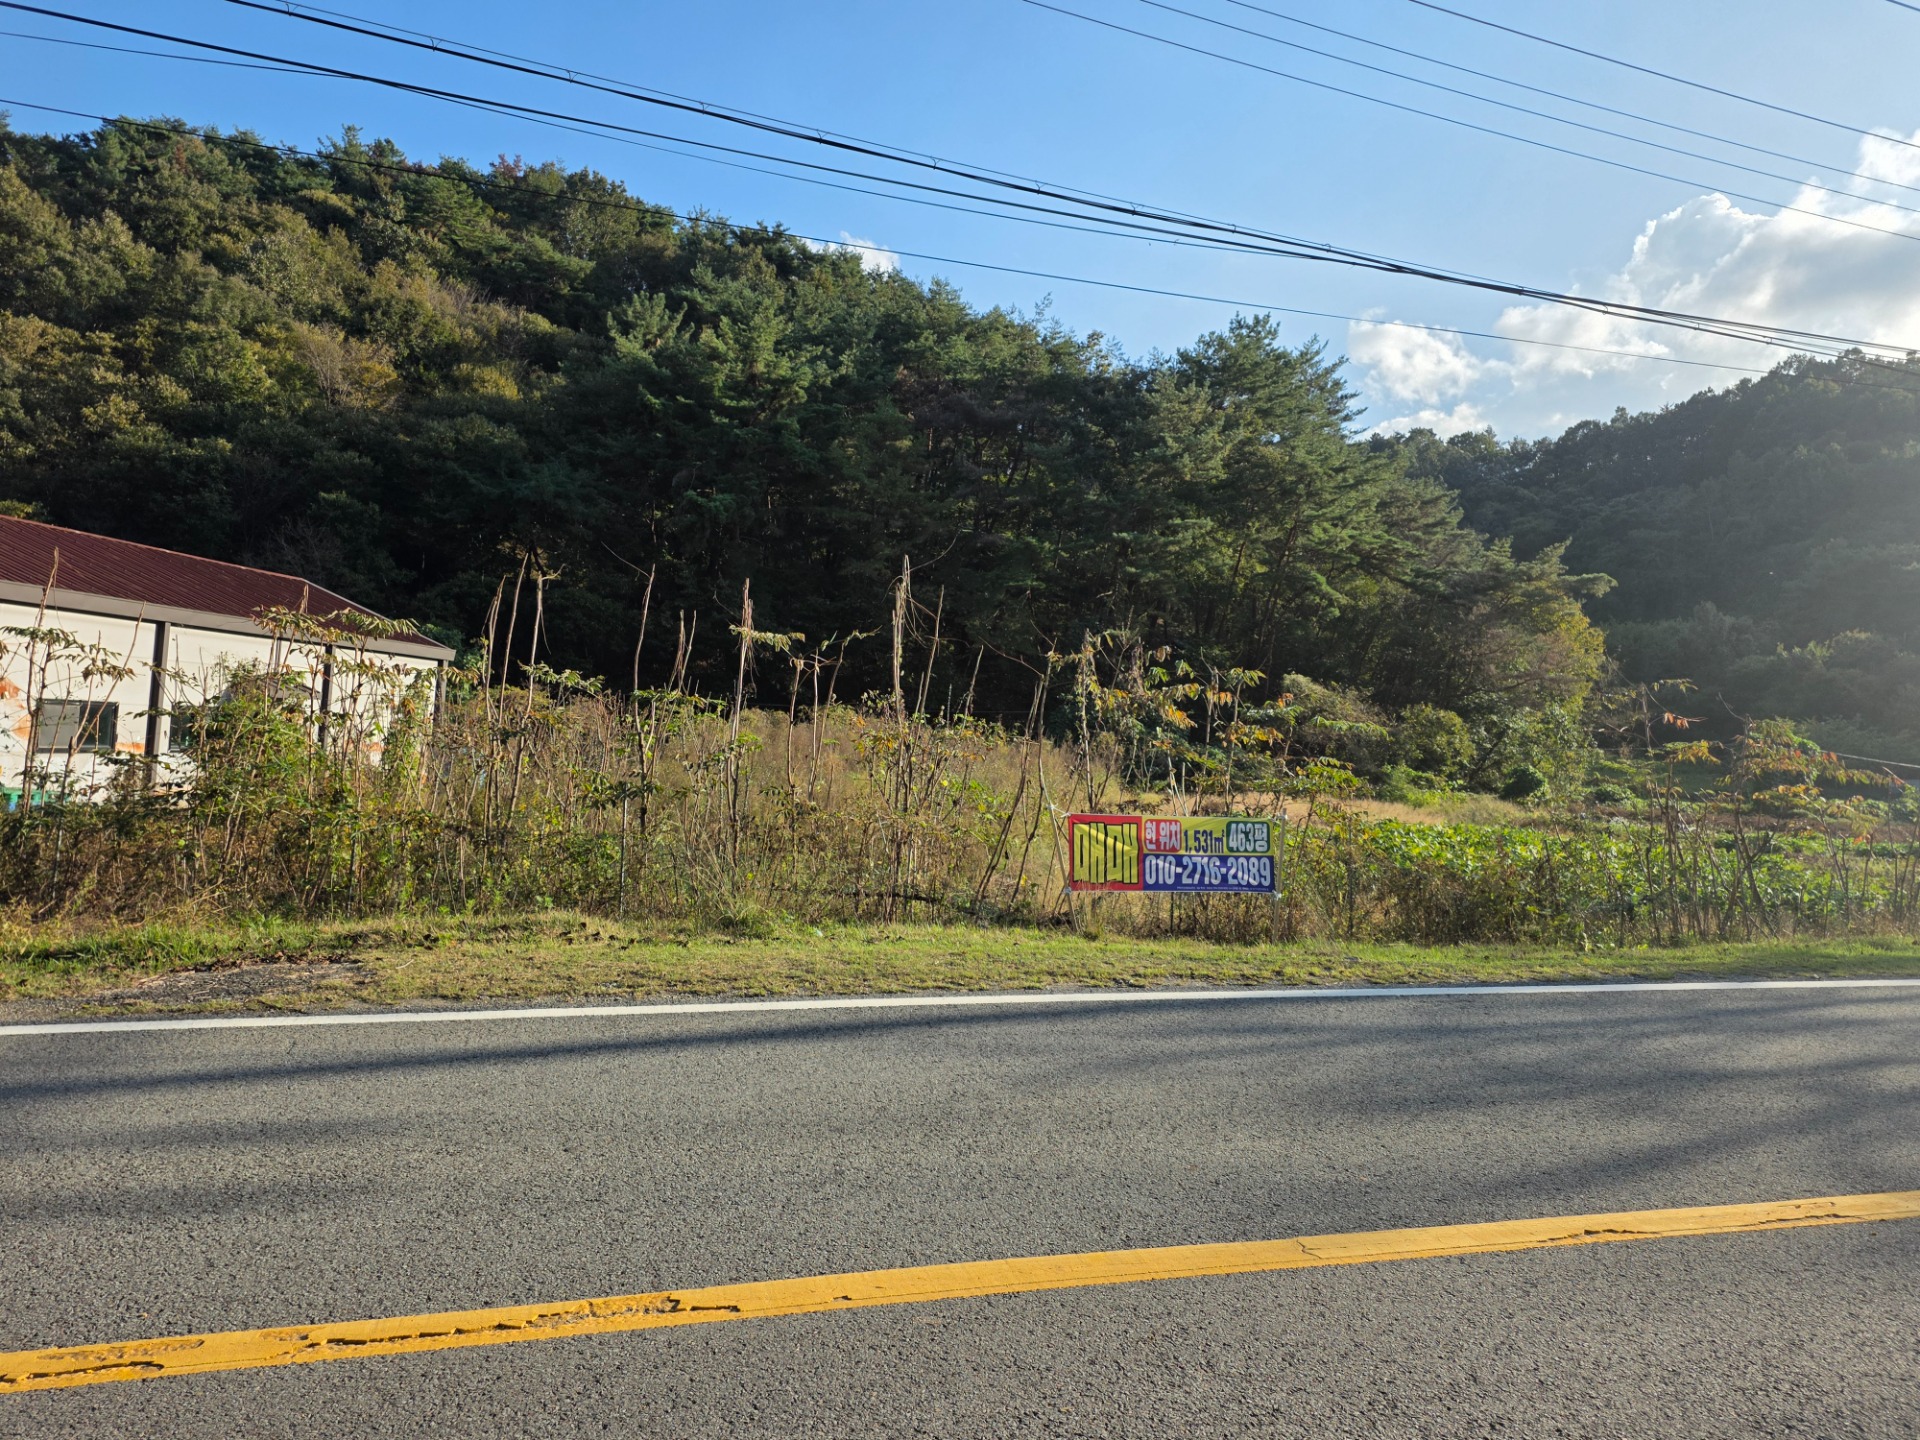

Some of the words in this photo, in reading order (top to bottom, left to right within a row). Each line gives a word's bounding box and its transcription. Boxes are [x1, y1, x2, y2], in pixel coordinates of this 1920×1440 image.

[1145, 821, 1157, 850] 현
[1159, 821, 1181, 850] 위치
[1228, 822, 1268, 852] 463평
[1073, 822, 1139, 884] 매매
[1145, 856, 1271, 886] 010-2716-2089
